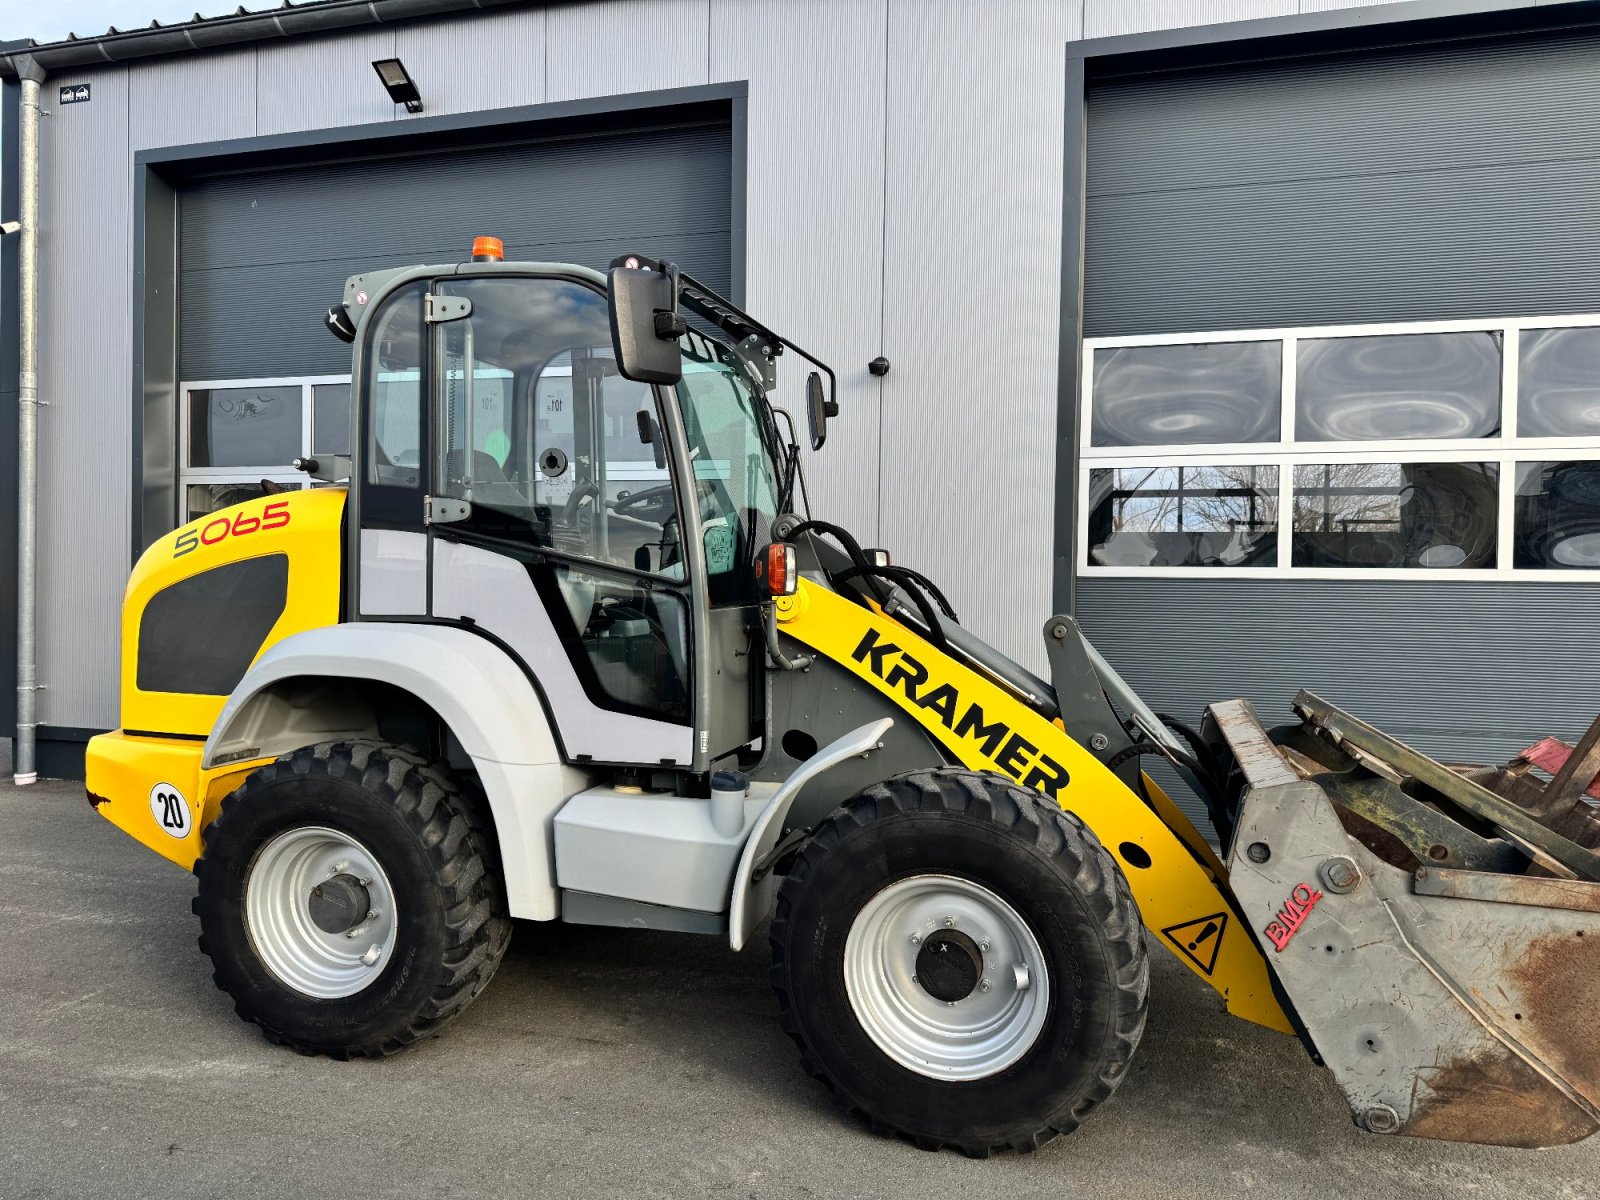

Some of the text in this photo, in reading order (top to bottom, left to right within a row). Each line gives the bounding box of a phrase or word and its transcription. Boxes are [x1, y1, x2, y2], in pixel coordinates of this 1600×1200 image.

[174, 501, 290, 558] 5065
[851, 627, 1071, 800] KRAMER
[157, 792, 184, 829] 20
